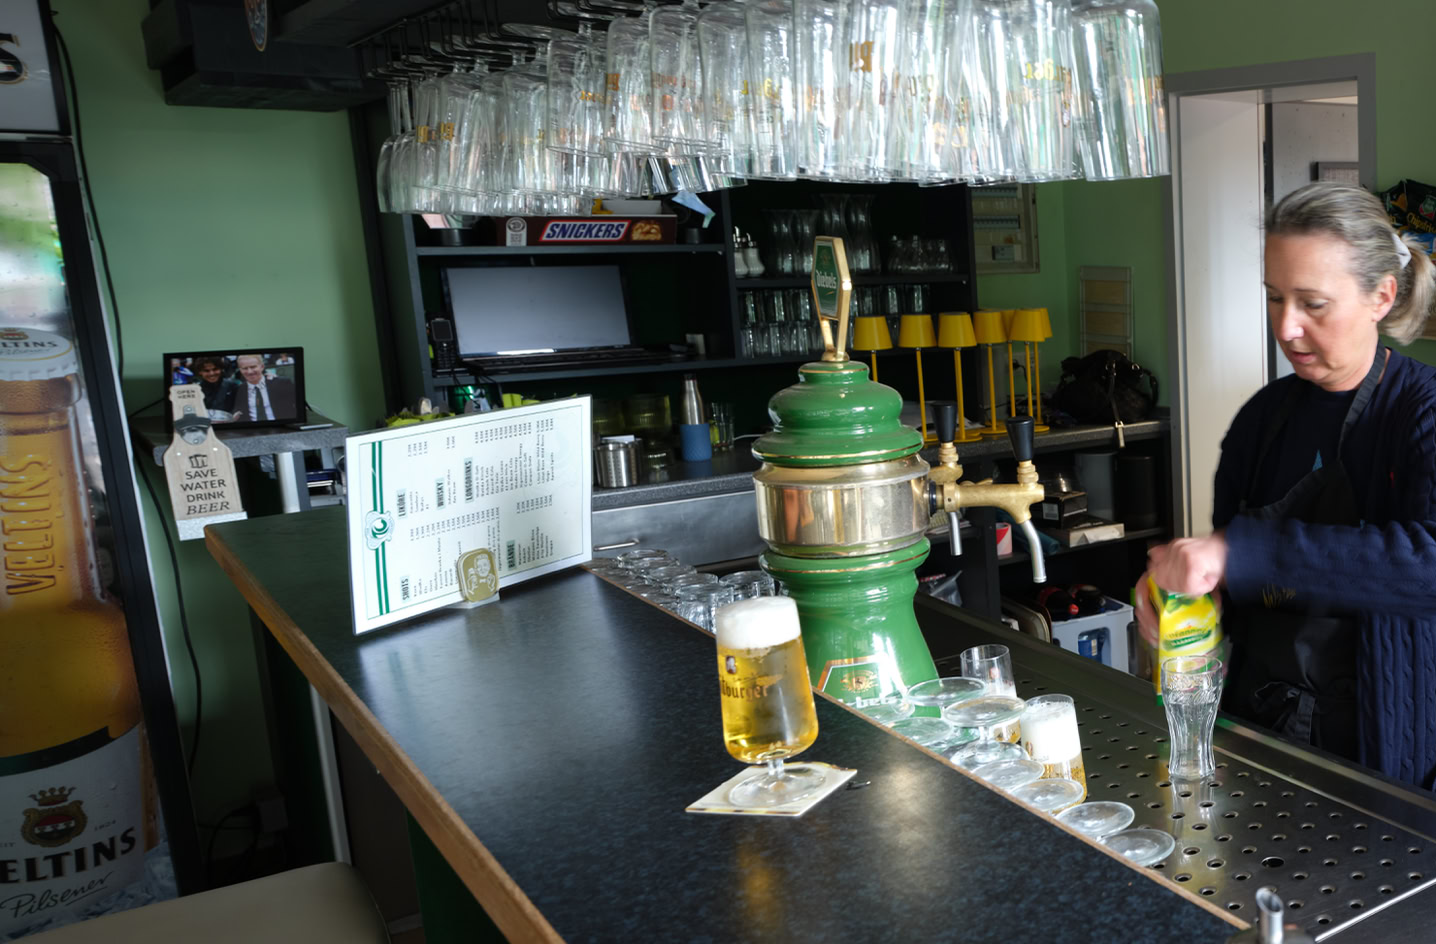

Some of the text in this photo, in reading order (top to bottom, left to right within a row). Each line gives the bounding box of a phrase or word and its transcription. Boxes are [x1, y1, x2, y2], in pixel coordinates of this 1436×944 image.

[546, 223, 626, 239] SNICKERS
[180, 478, 227, 492] WATER
[185, 468, 218, 480] SAVE
[464, 460, 472, 501] LONGDRINKS
[186, 501, 230, 516] BEER
[187, 490, 225, 503] DRINK
[396, 492, 405, 517] LIKÖRE
[0, 454, 57, 596] VELTINS
[506, 542, 515, 568] BRÄNDE
[401, 577, 409, 600] SHOTS
[0, 826, 137, 884] ELTINS
[0, 870, 114, 919] Pilsener
